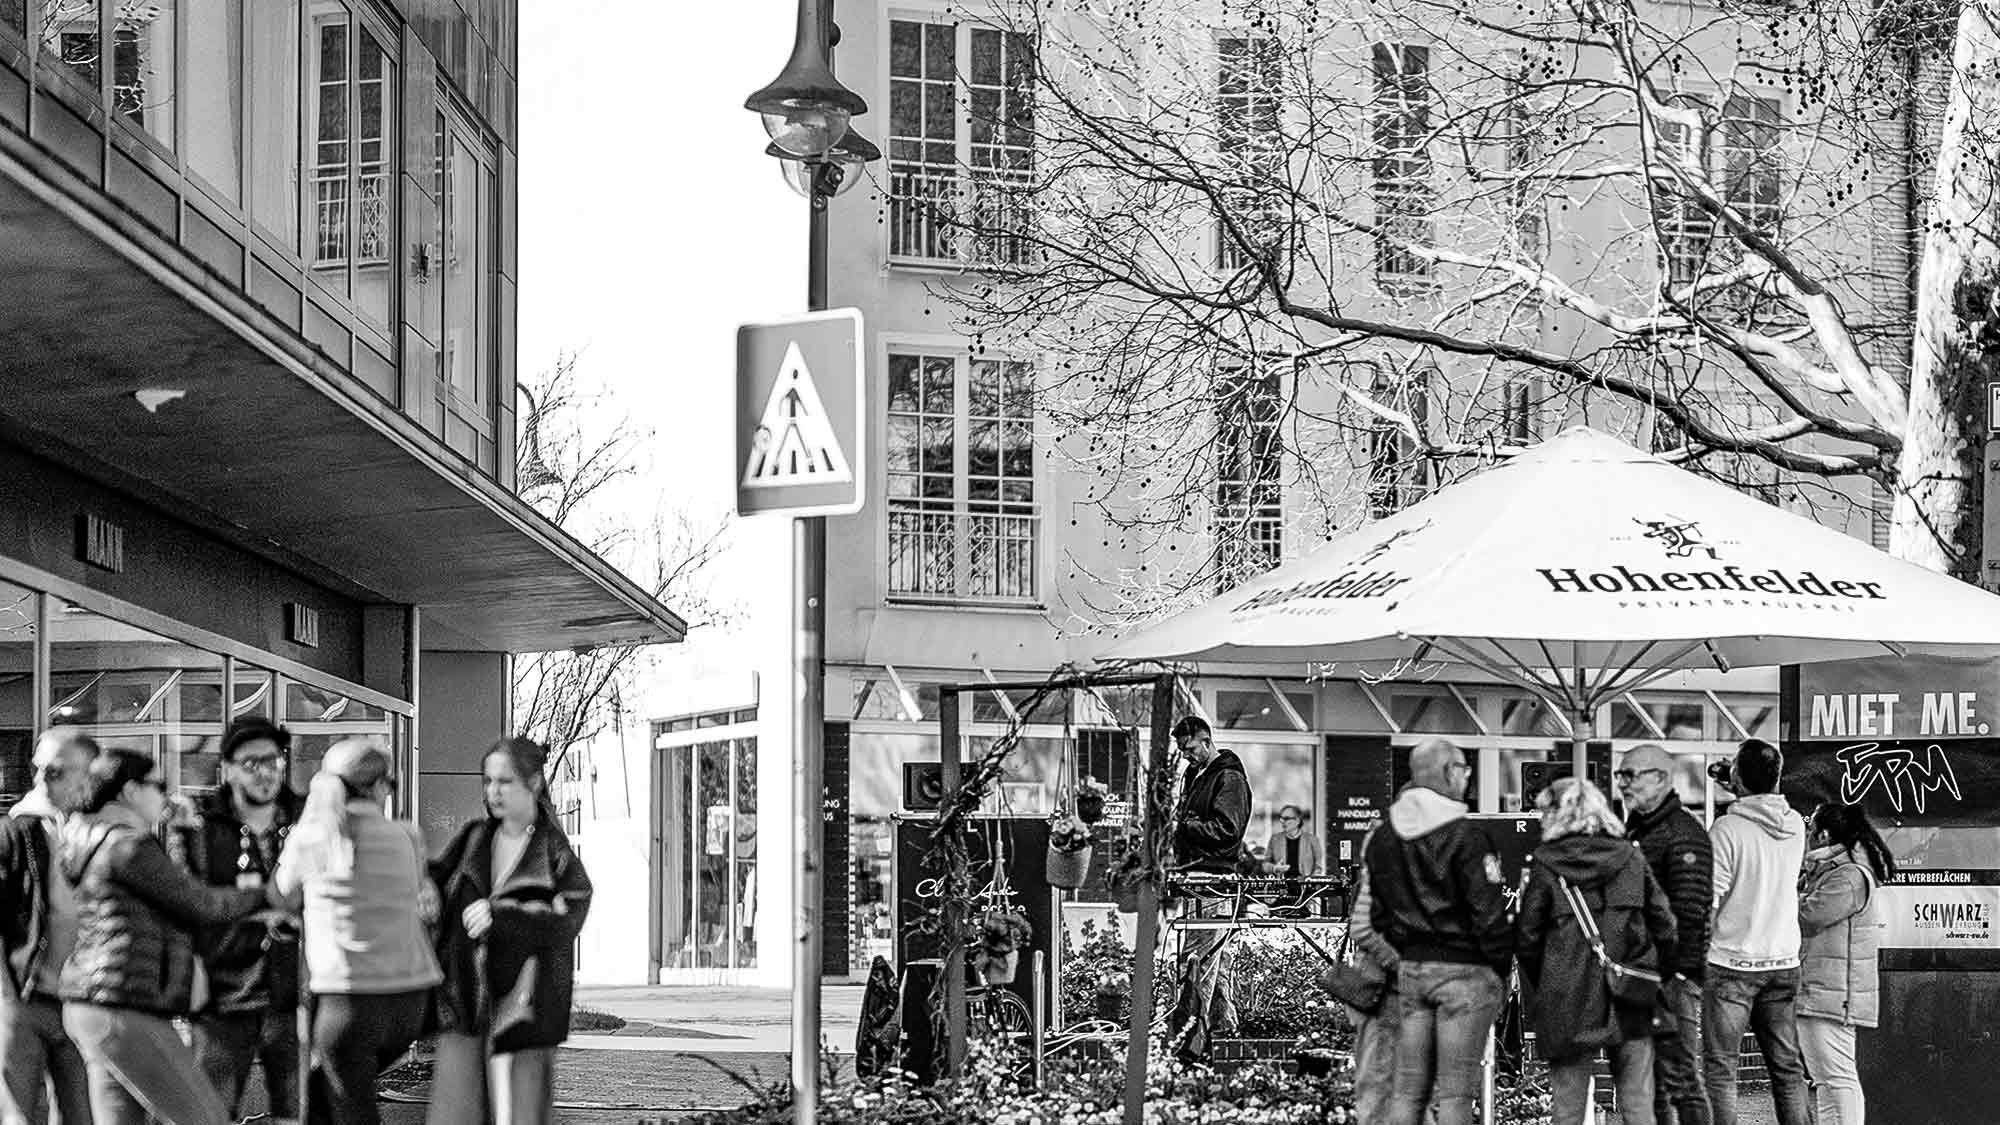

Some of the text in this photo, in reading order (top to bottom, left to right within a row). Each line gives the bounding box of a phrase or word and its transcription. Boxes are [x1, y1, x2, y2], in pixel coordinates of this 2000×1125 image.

[1536, 565, 1887, 600] Hohenfelder
[1810, 691, 1990, 737] MIET ME.
[1348, 797, 1370, 807] BUCH
[1337, 809, 1381, 819] HANDLUNG
[966, 820, 978, 833] L
[1515, 820, 1528, 833] R
[1907, 870, 1971, 883] WERBEFLÄCHEN
[1914, 903, 1982, 929] SCHWARZ
